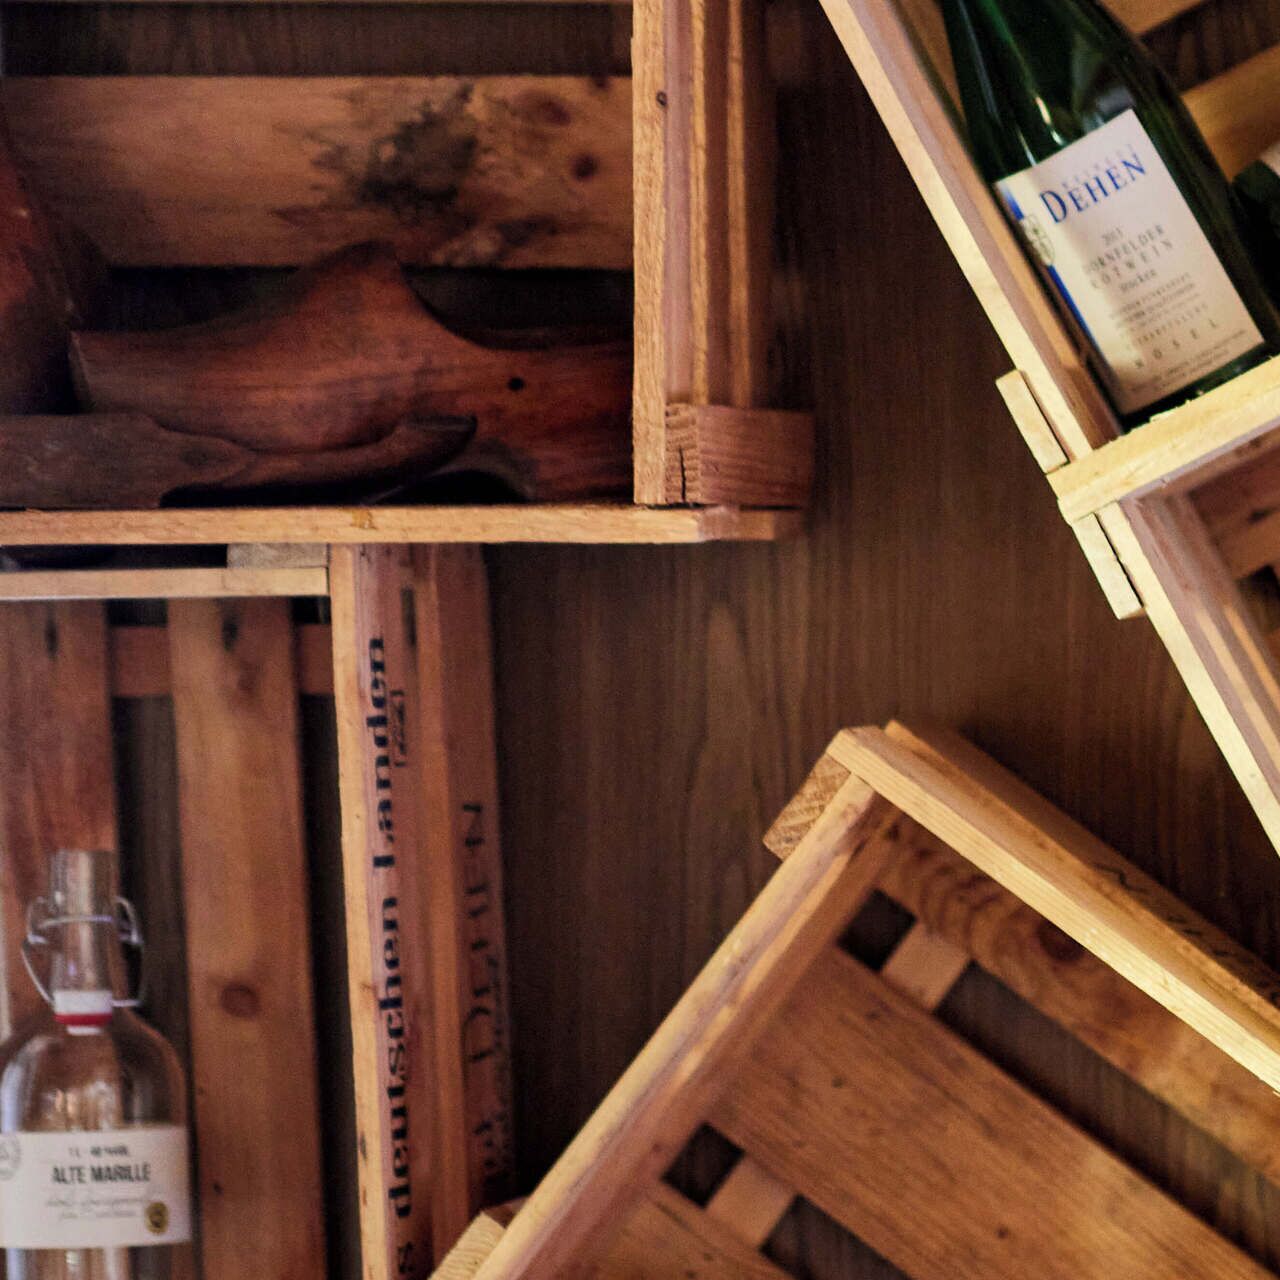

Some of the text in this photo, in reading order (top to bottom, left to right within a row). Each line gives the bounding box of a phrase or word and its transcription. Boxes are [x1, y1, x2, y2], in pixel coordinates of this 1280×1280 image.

[1039, 153, 1147, 225] DEHEN
[365, 636, 396, 868] Landen
[379, 896, 412, 1218] deutschen
[53, 1162, 151, 1184] ALTE MARILLE
